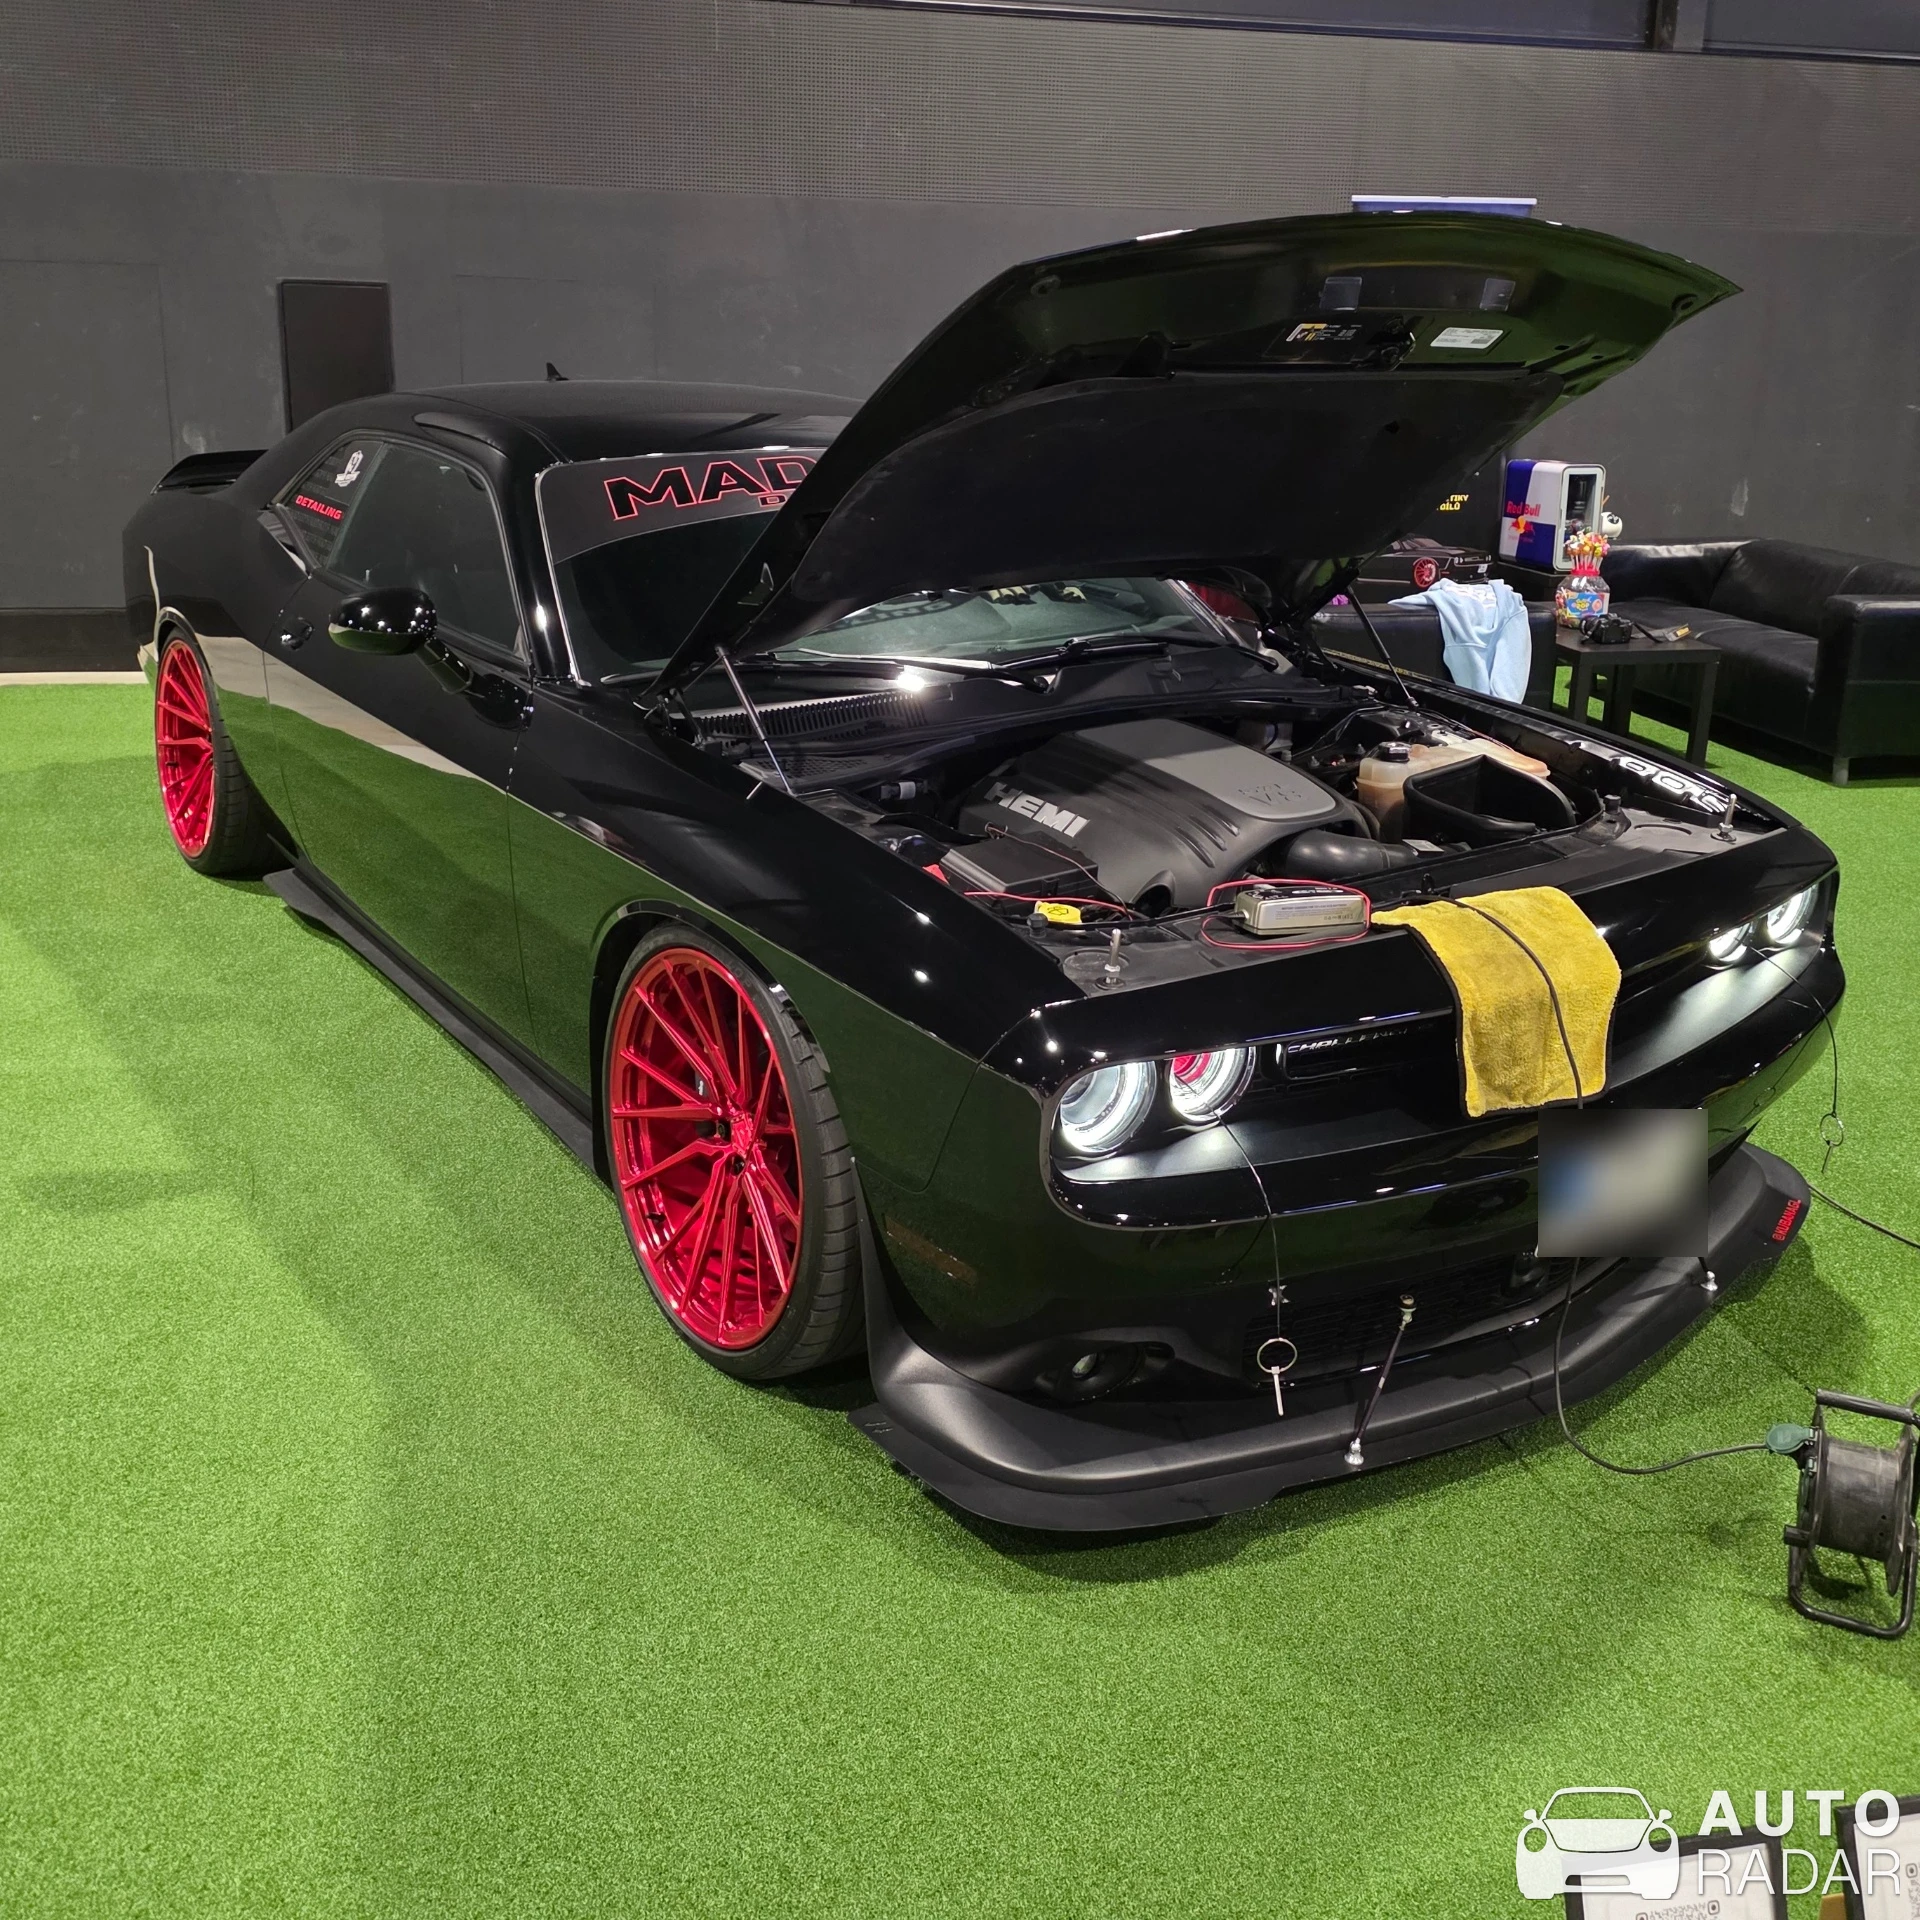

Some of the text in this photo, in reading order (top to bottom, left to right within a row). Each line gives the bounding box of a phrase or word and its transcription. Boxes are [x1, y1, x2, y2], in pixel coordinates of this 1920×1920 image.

[295, 494, 343, 520] DETAILING
[1506, 500, 1541, 517] Red Bull
[983, 781, 1090, 838] HEMI
